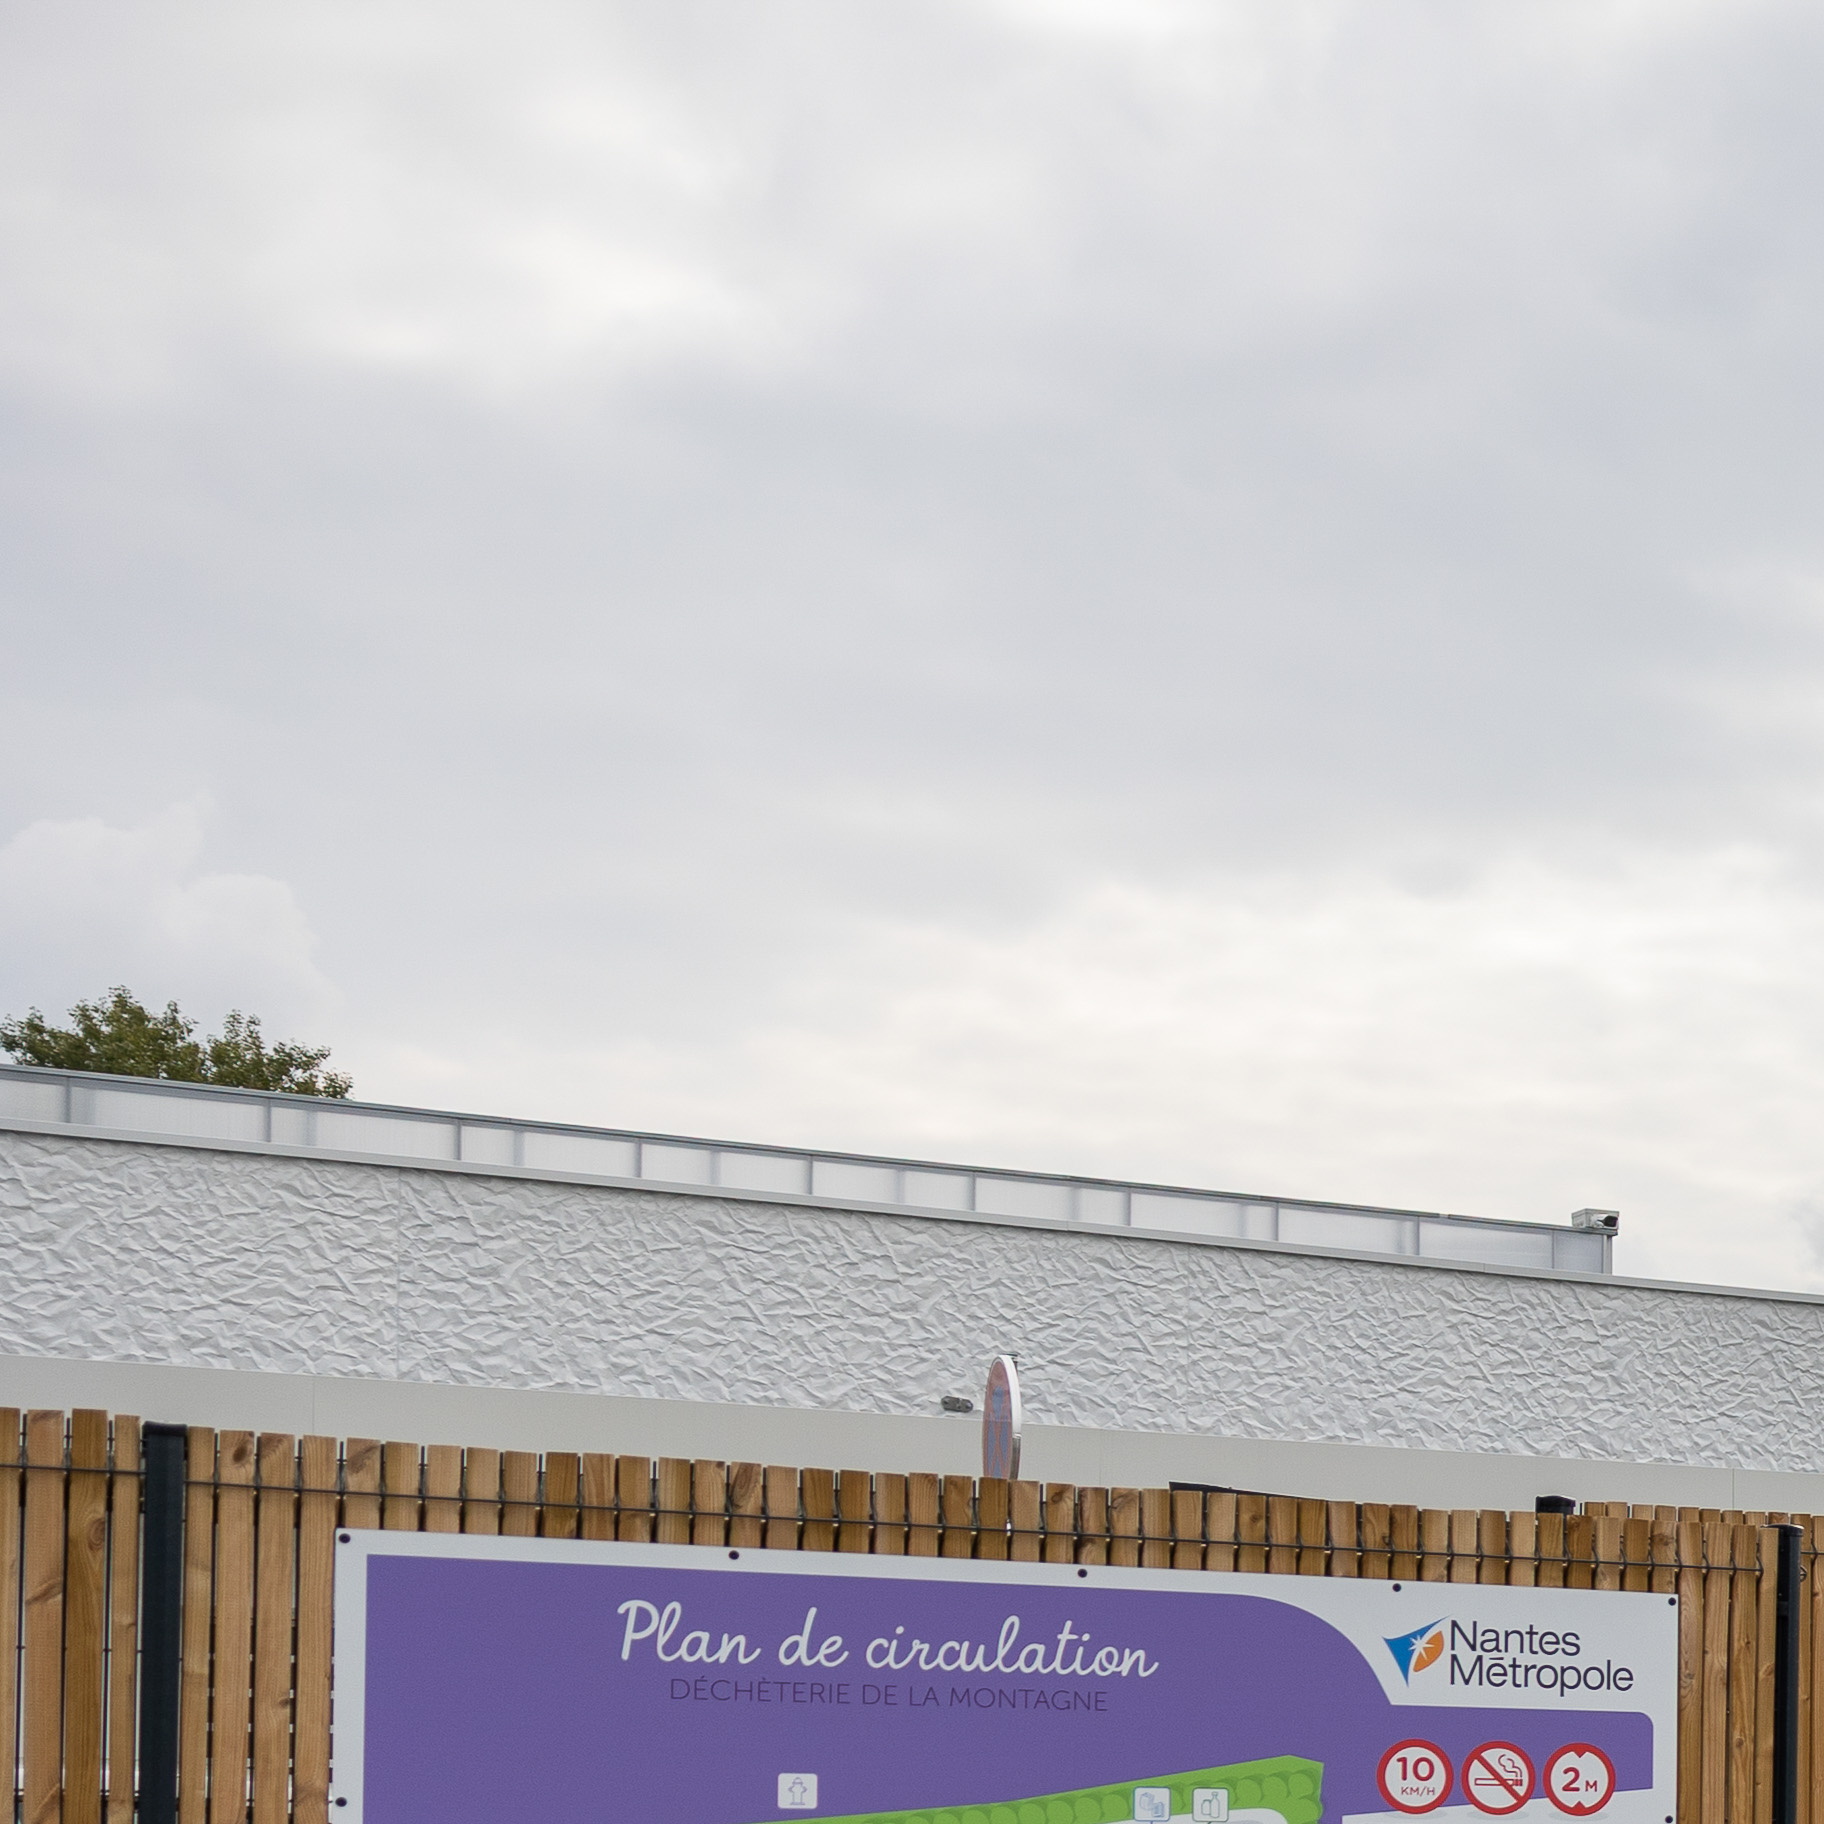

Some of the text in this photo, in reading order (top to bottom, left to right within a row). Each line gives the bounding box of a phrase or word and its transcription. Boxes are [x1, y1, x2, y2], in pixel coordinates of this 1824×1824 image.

[617, 1599, 1159, 1677] Plan de circulation
[1450, 1619, 1581, 1656] Nantes
[670, 1675, 1108, 1712] DÉCHÈTERIE DE LA MONTAGNE
[1450, 1653, 1634, 1697] Métropole
[1396, 1756, 1435, 1782] 10
[1561, 1767, 1598, 1792] 2 M
[1401, 1786, 1435, 1797] KM/H
